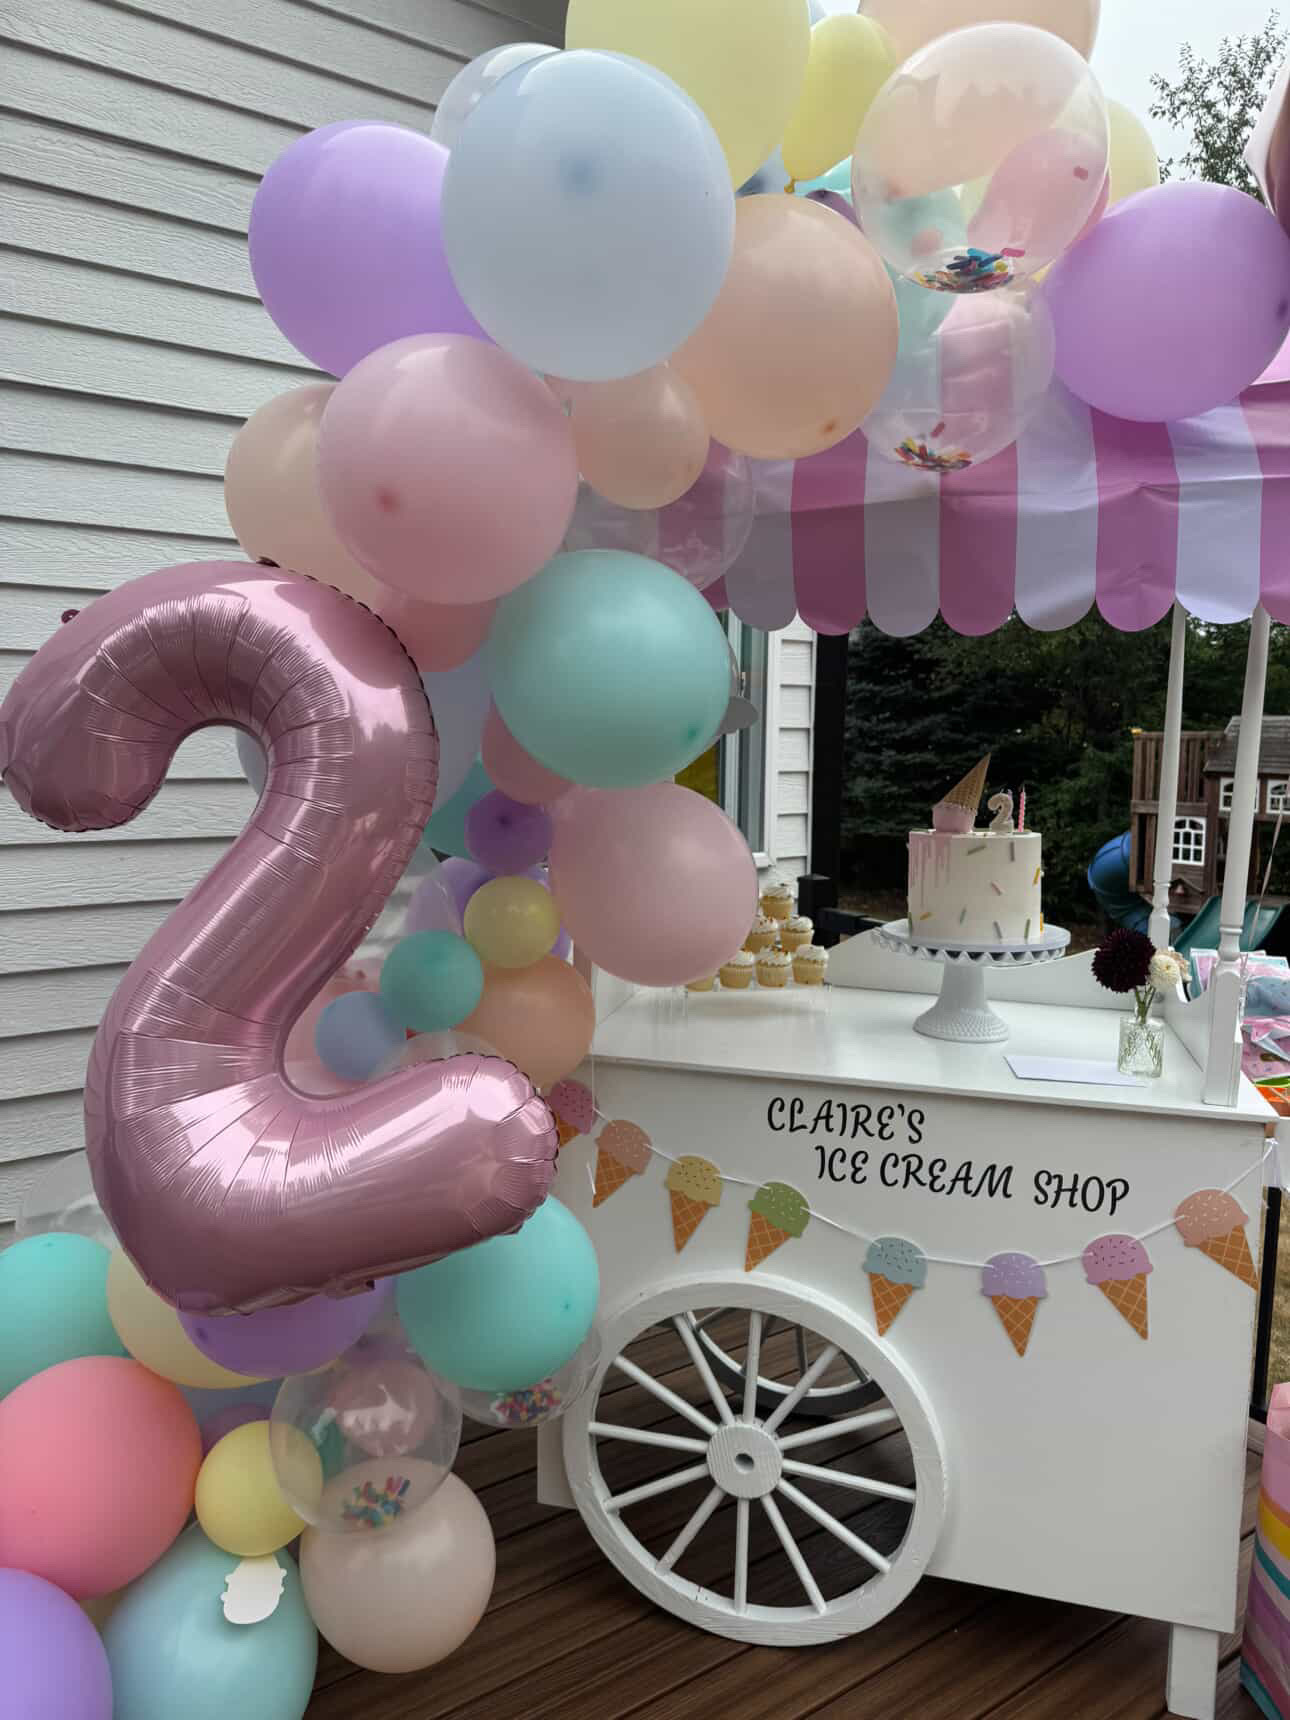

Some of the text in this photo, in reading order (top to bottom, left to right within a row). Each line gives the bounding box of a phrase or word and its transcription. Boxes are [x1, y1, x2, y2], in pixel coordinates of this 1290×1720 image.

[987, 792, 1015, 832] 2
[0, 560, 560, 1317] 2
[767, 1097, 926, 1145] CLAIRE'S
[814, 1145, 1131, 1216] ICE CREAM SHOP
